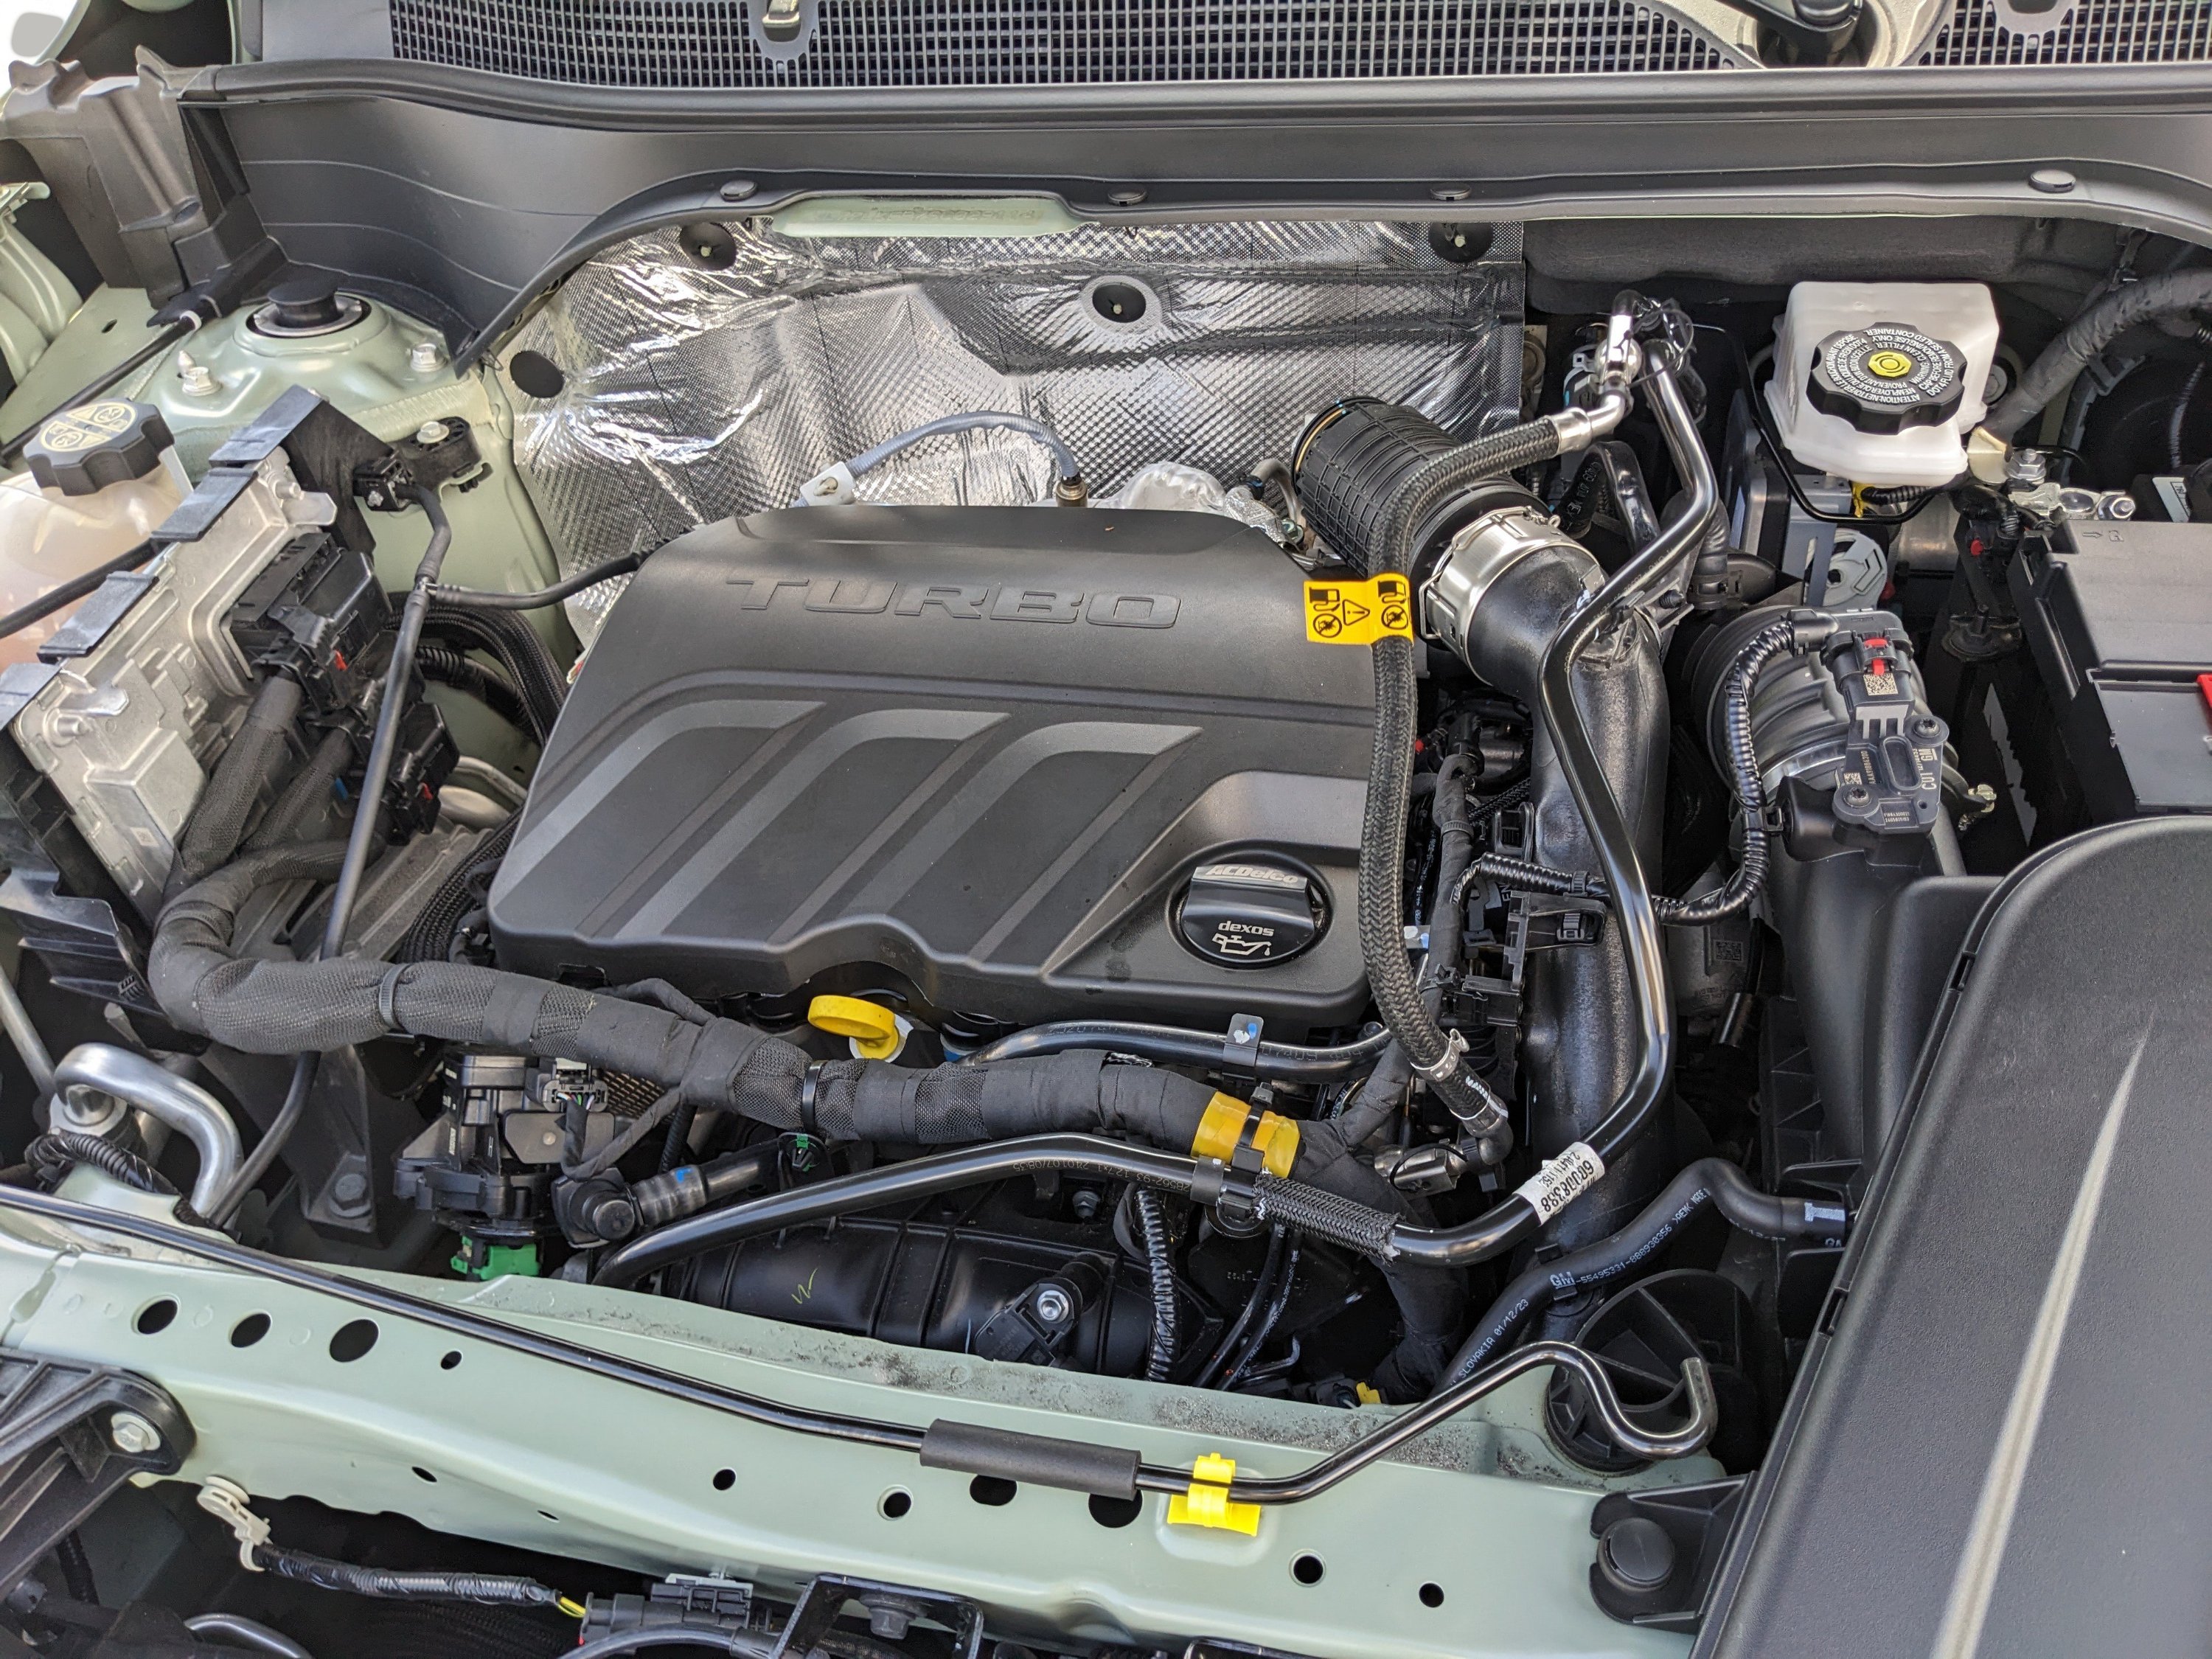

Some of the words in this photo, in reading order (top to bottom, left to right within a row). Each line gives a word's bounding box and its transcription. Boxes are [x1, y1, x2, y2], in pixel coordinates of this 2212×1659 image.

[1875, 341, 1905, 350] FILLER
[1914, 334, 1943, 351] SEALED
[1904, 346, 1926, 361] CLEAN
[1941, 354, 1954, 369] FROM
[1919, 378, 1933, 390] CAP
[1930, 361, 1942, 381] BEFORE
[1941, 369, 1954, 384] FLUID
[1856, 382, 1872, 392] QUE
[1926, 383, 1943, 396] DOT
[726, 578, 1181, 628] TURBO
[1919, 748, 1937, 761] GM
[1205, 866, 1298, 883] ACDelco
[1218, 920, 1275, 936] dexos
[1457, 1337, 1495, 1378] SLOVAKIA
[1494, 1298, 1530, 1338] 01/12/23
